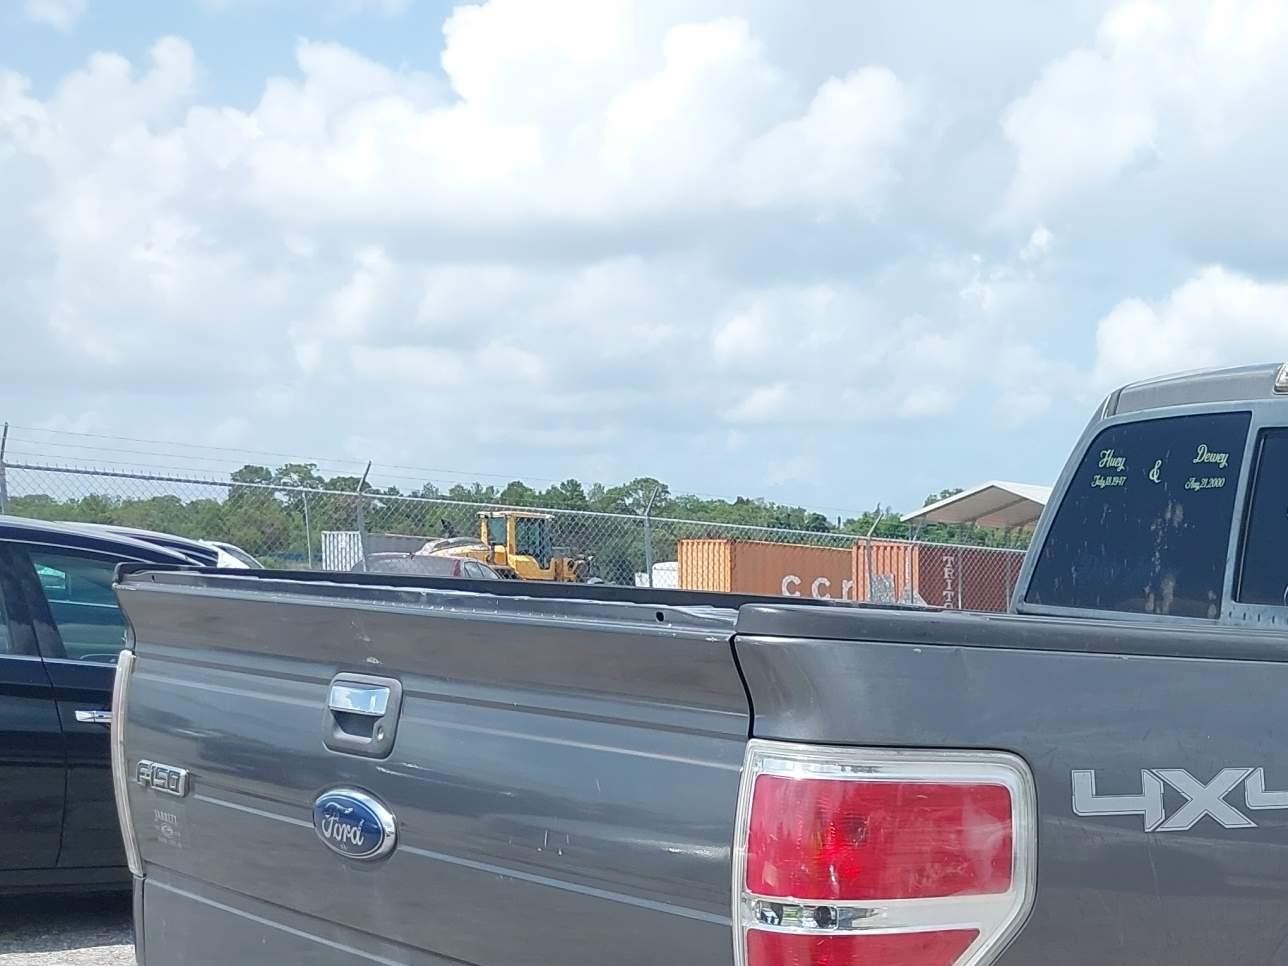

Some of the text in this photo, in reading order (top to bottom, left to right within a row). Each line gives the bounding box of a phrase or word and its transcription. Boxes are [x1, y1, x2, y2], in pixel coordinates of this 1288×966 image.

[1099, 443, 1229, 483] Huey & Dewey
[321, 801, 365, 846] Ford
